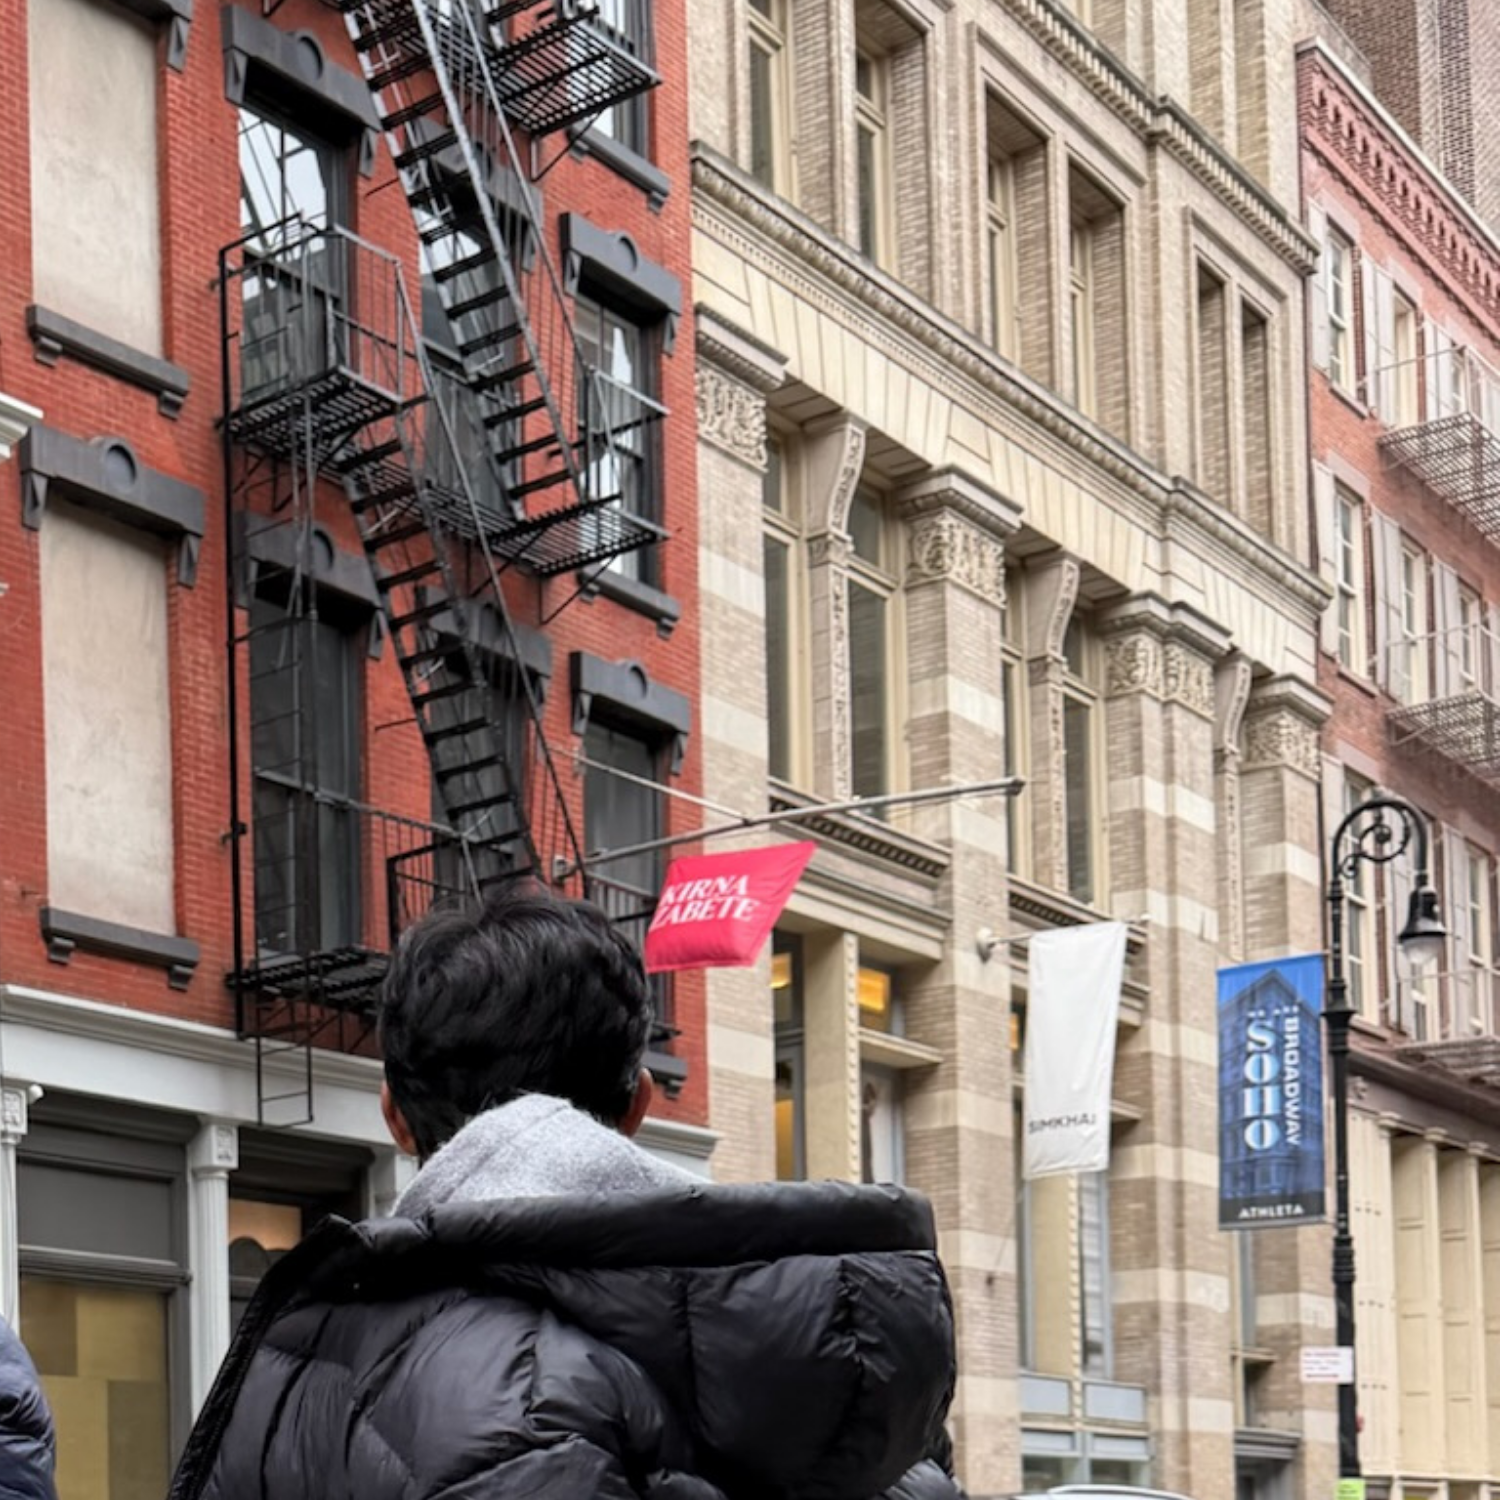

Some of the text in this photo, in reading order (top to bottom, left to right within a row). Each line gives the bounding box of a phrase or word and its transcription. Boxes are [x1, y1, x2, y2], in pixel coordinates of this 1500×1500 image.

[661, 875, 749, 907] KIRNA
[1283, 1016, 1301, 1146] BROADWAY
[1238, 1203, 1304, 1220] ATHLETA
